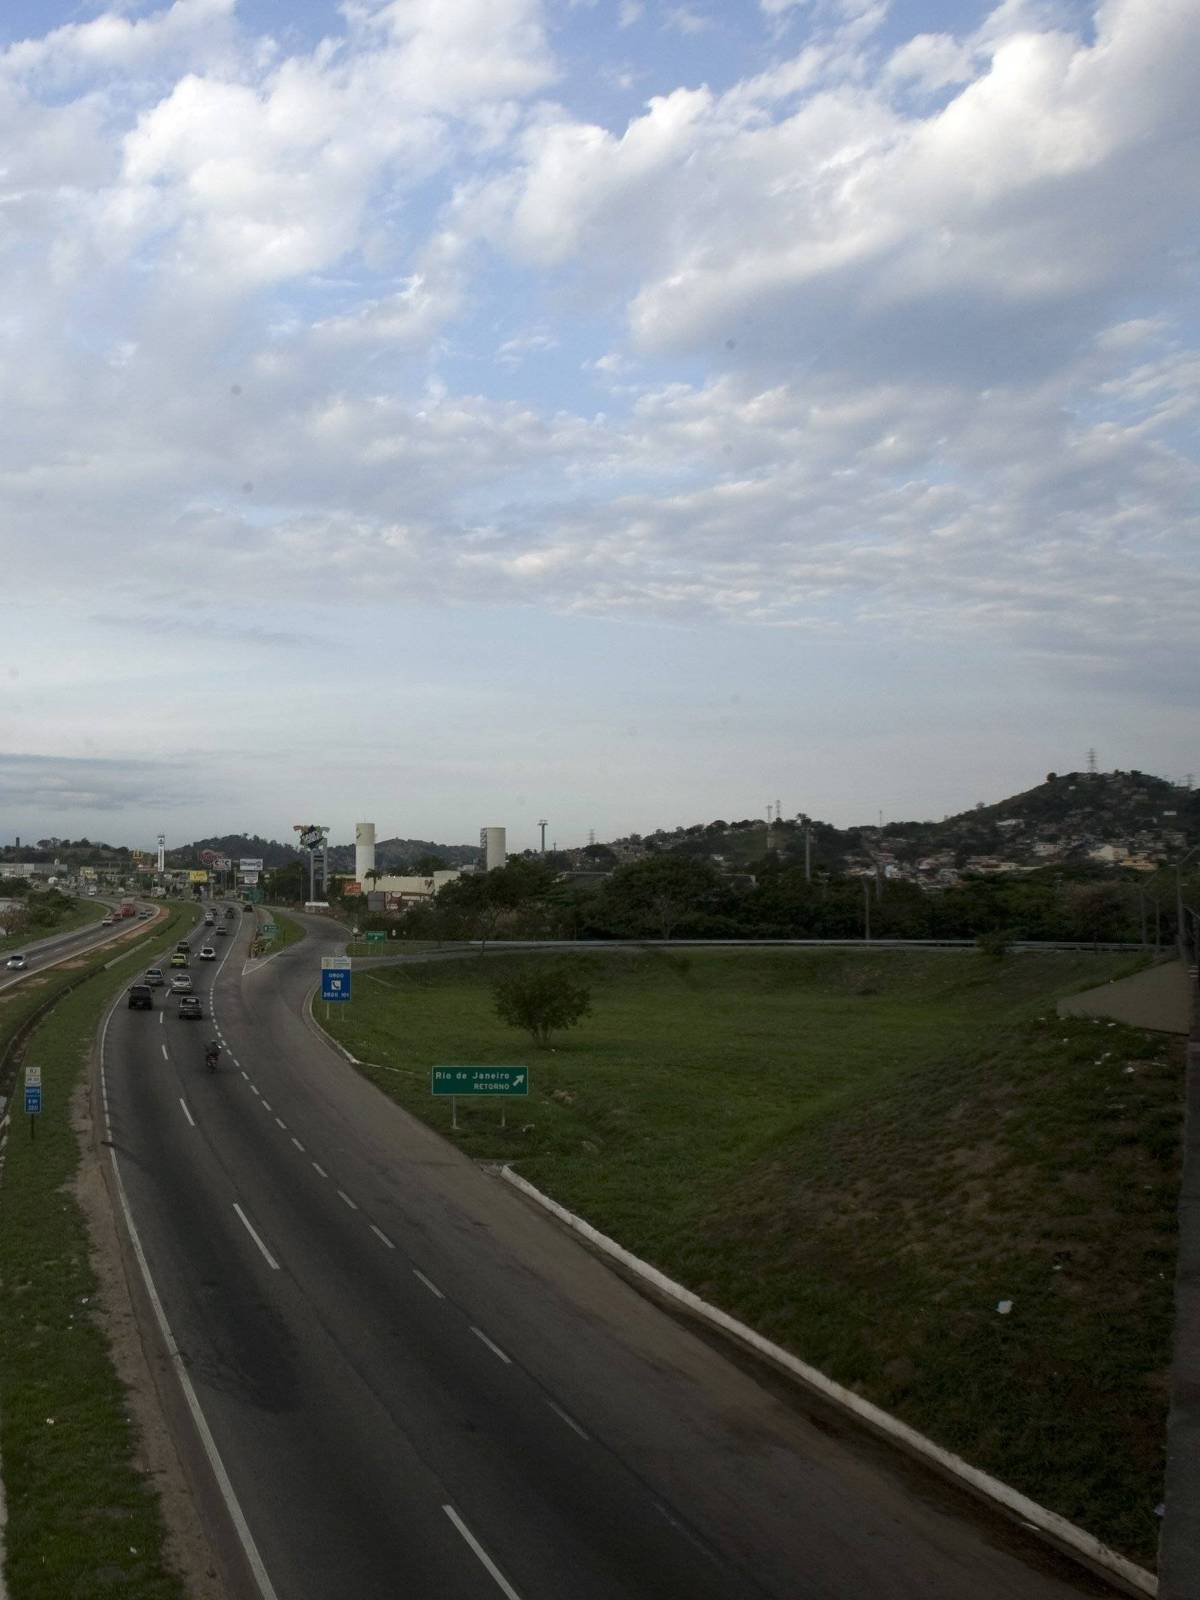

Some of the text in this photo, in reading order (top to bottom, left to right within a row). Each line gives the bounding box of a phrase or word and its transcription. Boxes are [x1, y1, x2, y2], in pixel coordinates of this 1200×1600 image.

[435, 1071, 510, 1080] Rio de Janeiro
